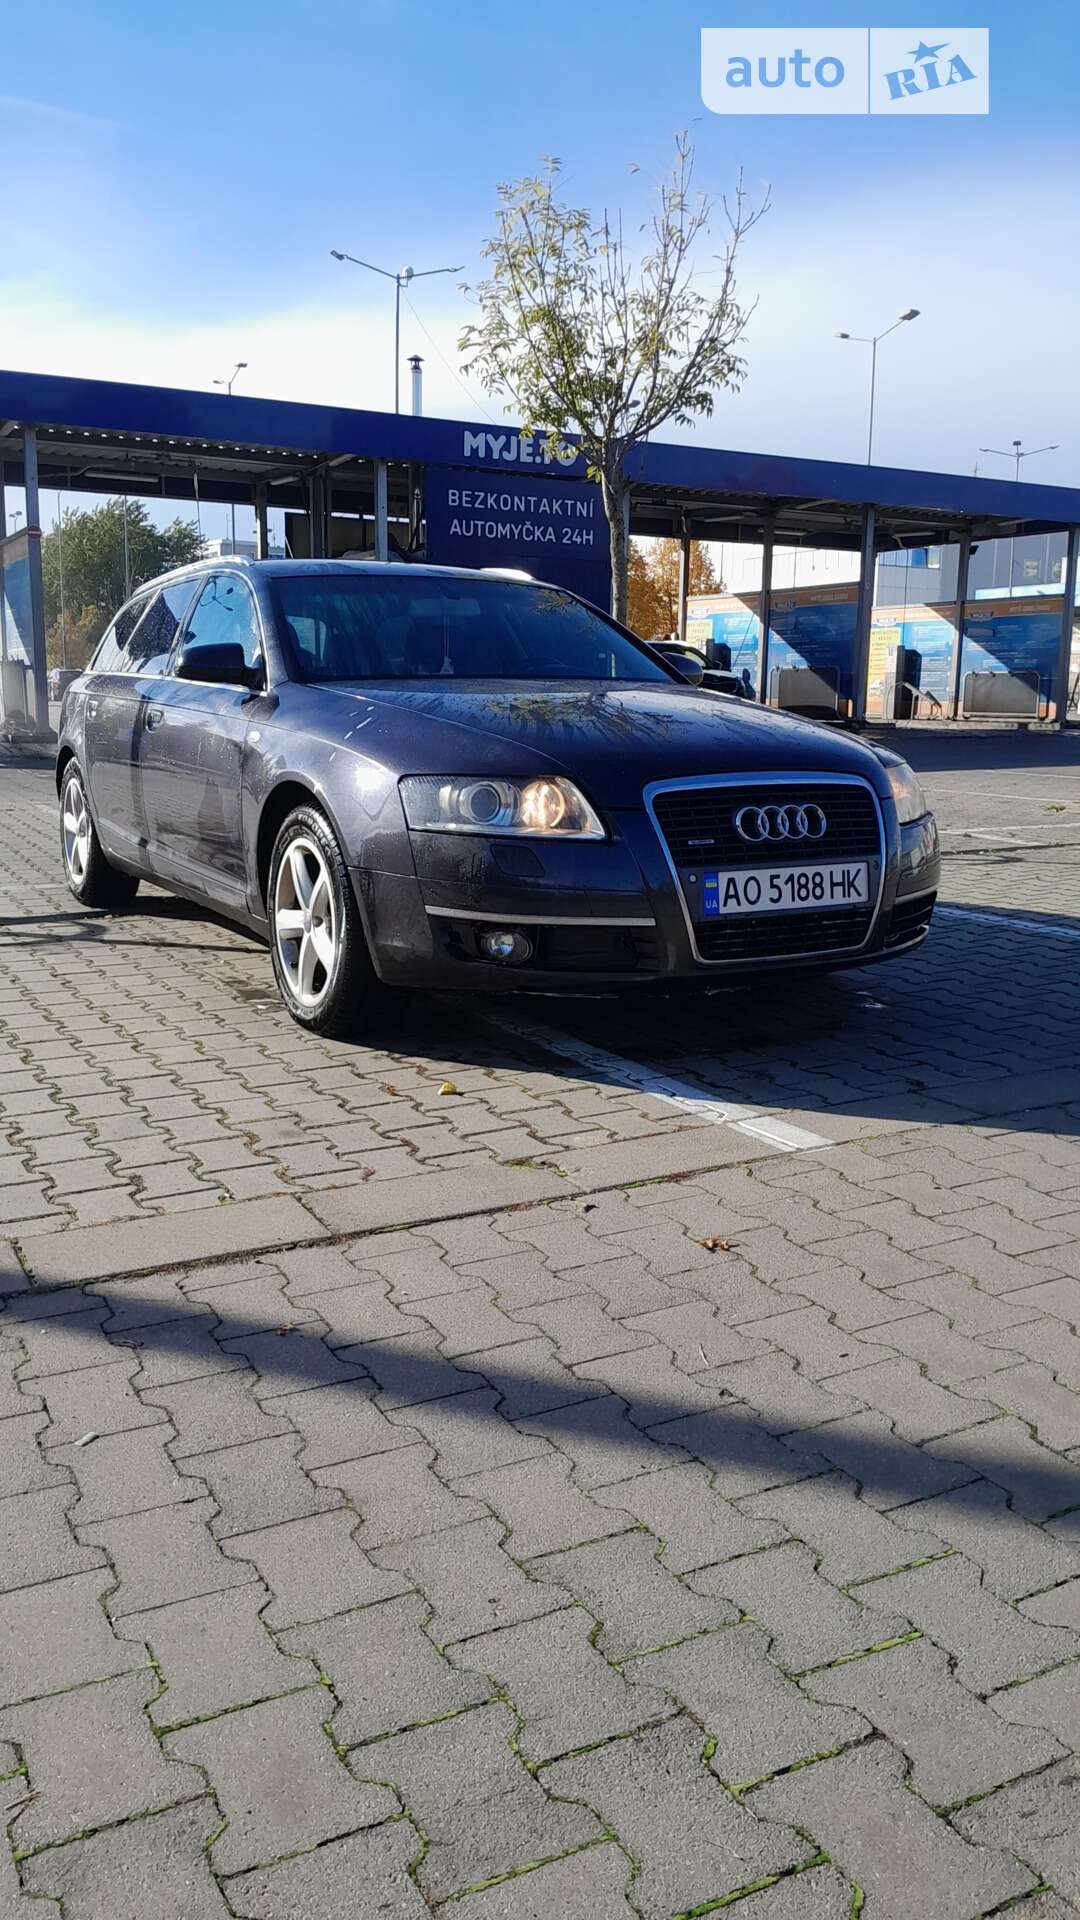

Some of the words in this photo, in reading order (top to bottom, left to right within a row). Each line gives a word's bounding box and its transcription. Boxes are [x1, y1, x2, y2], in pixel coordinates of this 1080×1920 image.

[448, 489, 594, 518] BEZKONTAKTNÍ
[449, 519, 556, 543] AUTOMYČKA
[562, 527, 594, 546] 24H
[722, 875, 762, 908] AO
[769, 871, 825, 904] 5188
[830, 867, 862, 900] HK
[705, 900, 718, 909] UA
